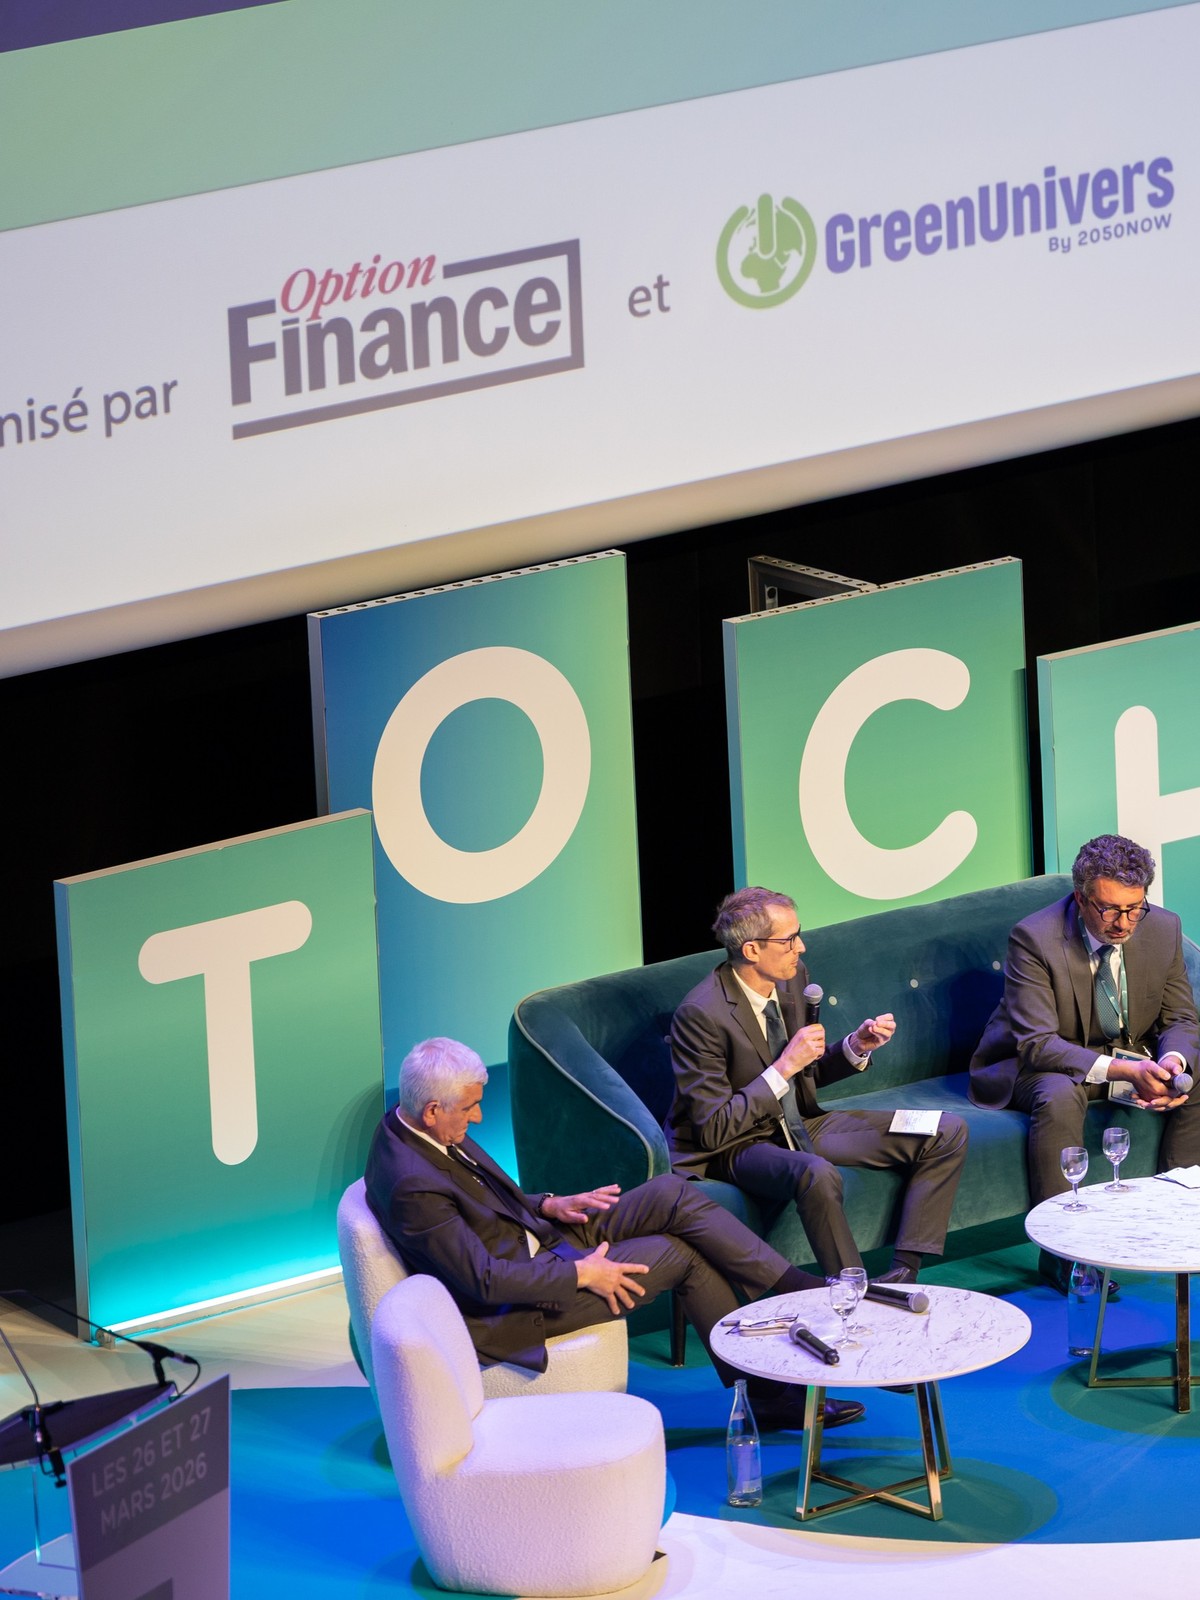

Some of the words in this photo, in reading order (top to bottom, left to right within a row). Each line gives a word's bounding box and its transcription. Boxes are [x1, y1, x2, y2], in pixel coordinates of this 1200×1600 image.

[825, 156, 1175, 274] GreenUnivers
[1048, 236, 1072, 254] By
[1078, 212, 1172, 247] 2050NOW
[280, 252, 436, 322] Option
[627, 273, 671, 318] et
[227, 272, 562, 407] Finance
[103, 379, 178, 438] par
[92, 1456, 127, 1498] LES
[132, 1439, 155, 1475] 26
[160, 1422, 184, 1459] ET
[189, 1406, 212, 1442] 27
[101, 1482, 155, 1535] MARS
[160, 1451, 208, 1501] 2026
